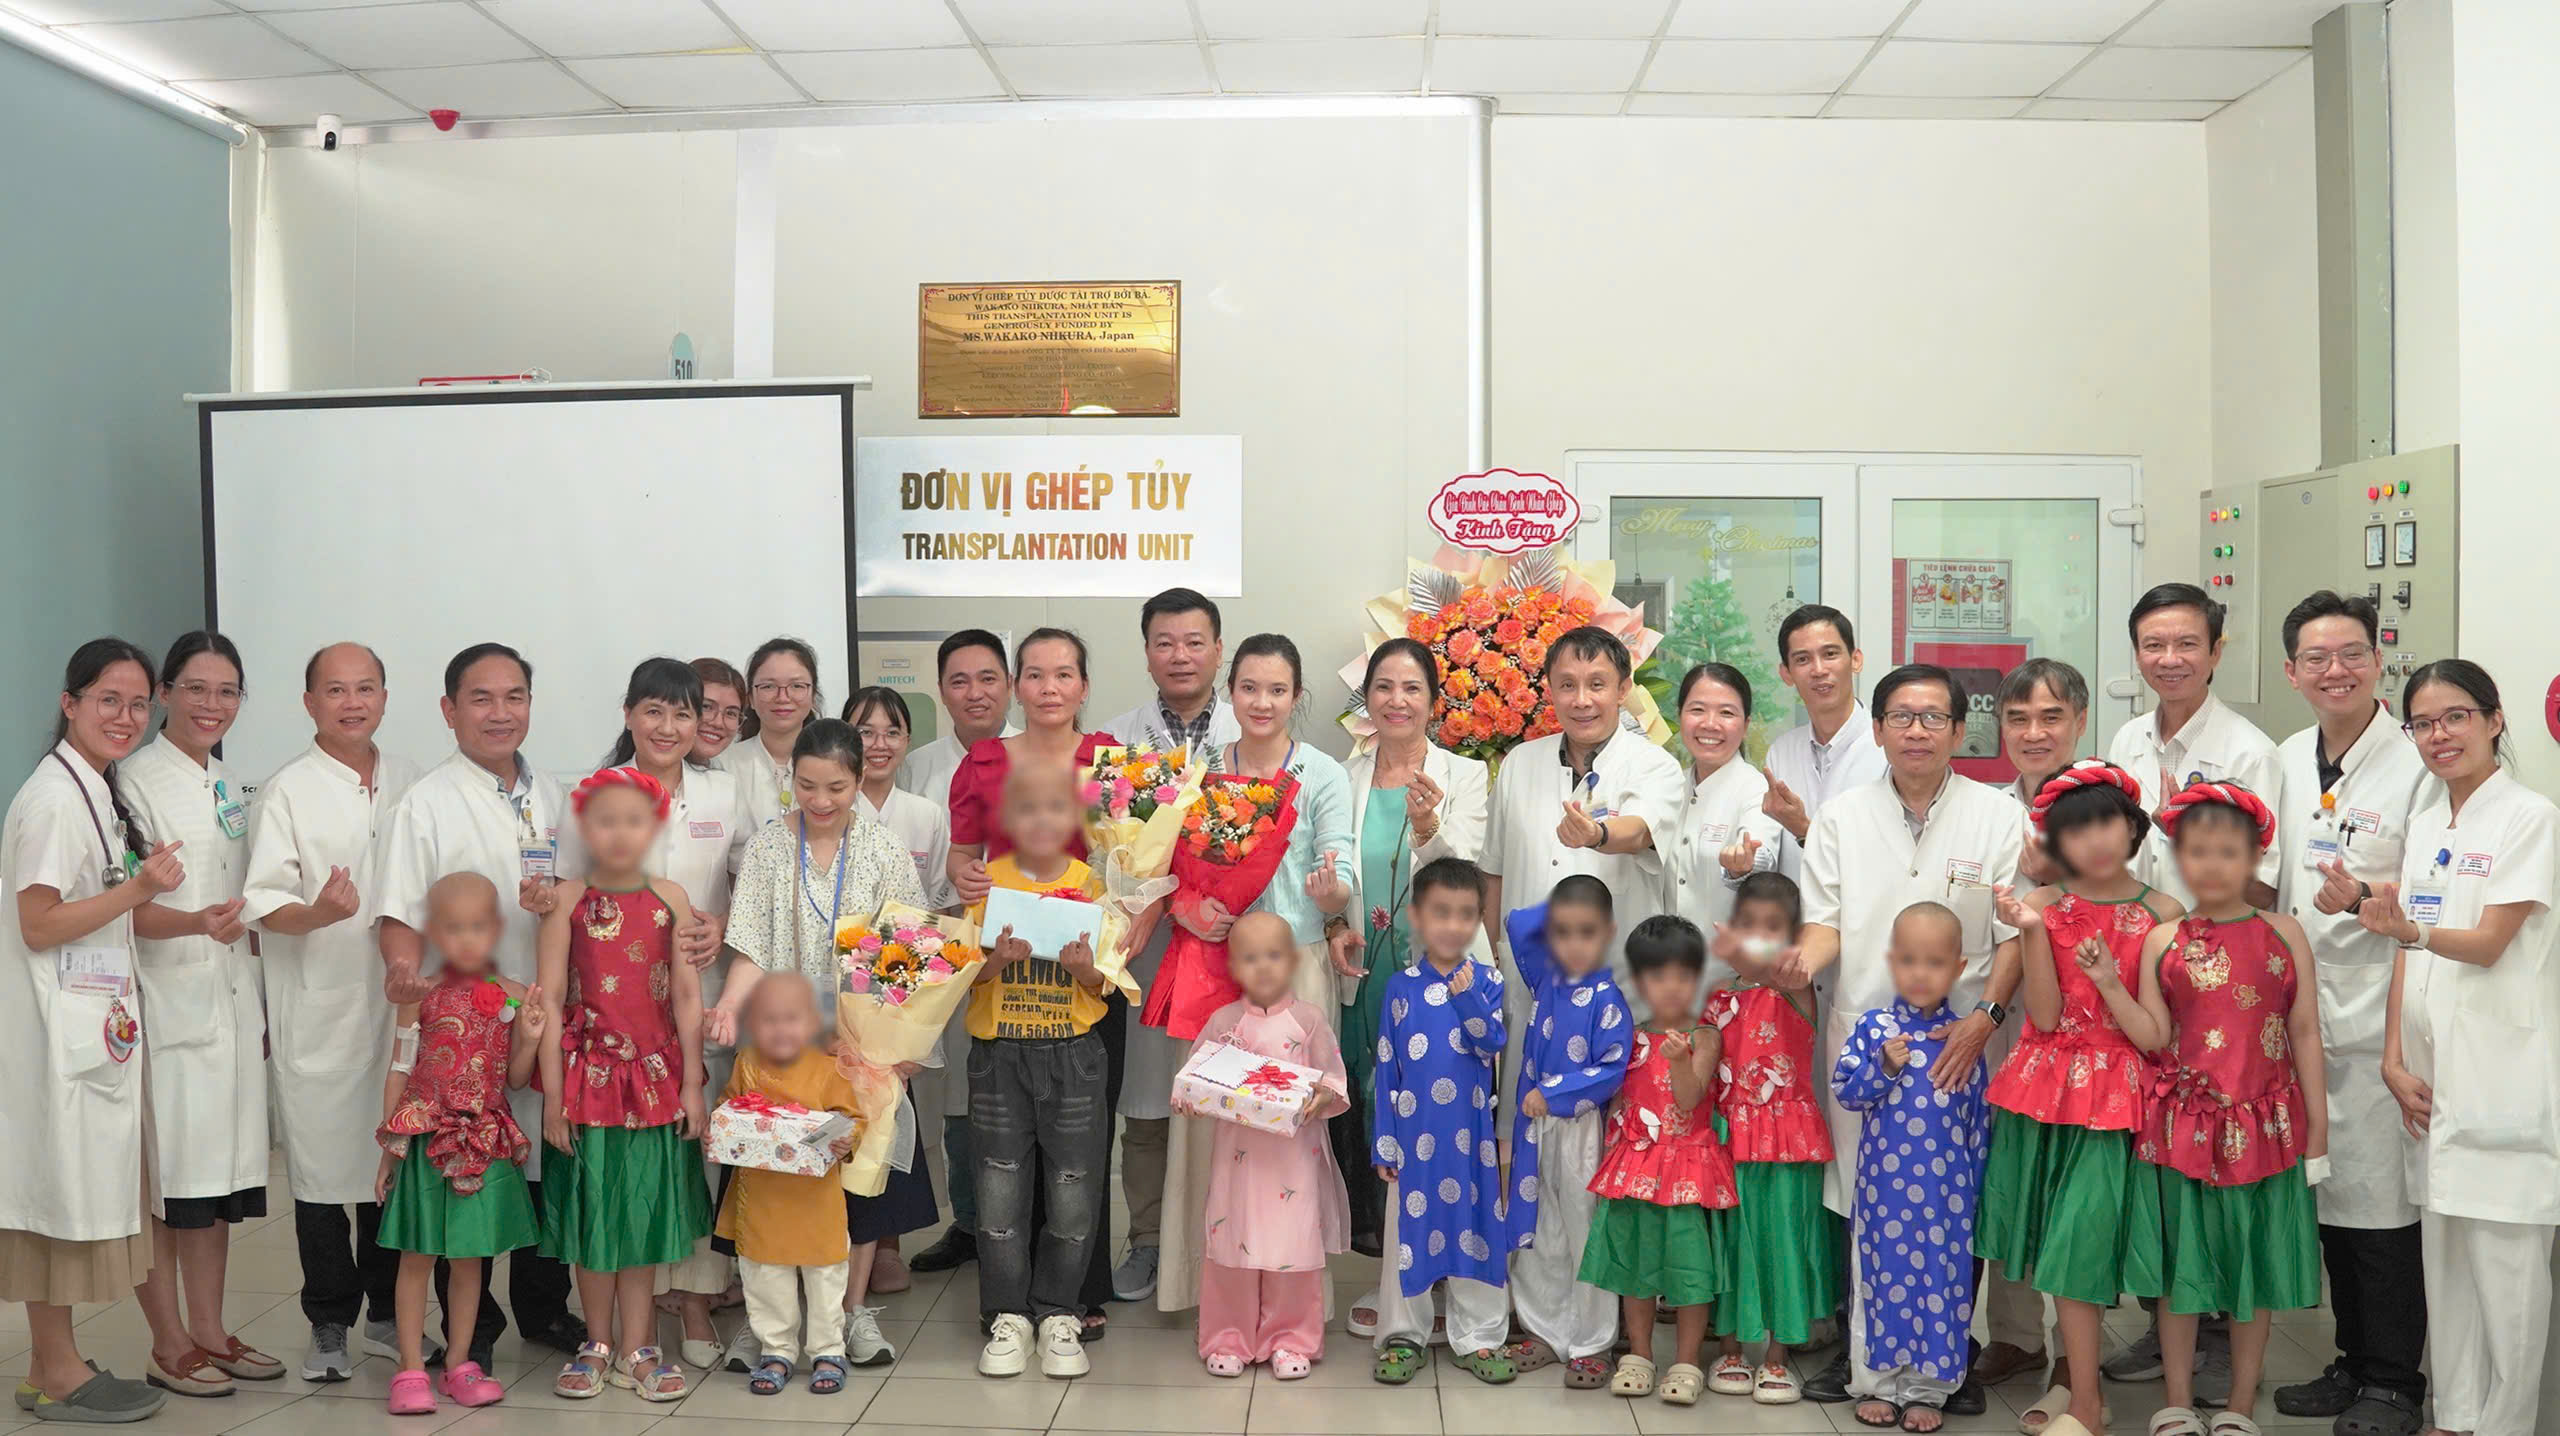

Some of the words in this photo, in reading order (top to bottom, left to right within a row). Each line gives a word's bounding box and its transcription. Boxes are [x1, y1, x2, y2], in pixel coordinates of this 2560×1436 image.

[985, 291, 1013, 300] GHÉP
[1016, 290, 1036, 300] TỦY
[1090, 290, 1110, 301] TRỢ
[1114, 289, 1131, 299] BỞI
[974, 303, 1018, 311] WAKAKO
[992, 312, 1091, 320] TRANSPLANTATION
[1094, 311, 1119, 319] UNIT
[984, 322, 1052, 330] GENEROUSLY
[1055, 321, 1097, 329] FUNDED
[963, 332, 1037, 342] MS.WAKAKO
[1099, 331, 1134, 342] Japan
[675, 359, 693, 380] 510
[901, 468, 970, 510] ĐƠN
[981, 472, 1011, 517] VỊ
[1026, 464, 1114, 510] GHÉP
[1126, 458, 1193, 510] TỦY
[1506, 519, 1555, 542] Tặng
[1620, 507, 1716, 538] Merry
[1712, 525, 1817, 552] Christmas
[902, 532, 1127, 560] TRANSPLANTATION
[1138, 533, 1194, 560] UNIT
[877, 675, 915, 684] AIRTECH
